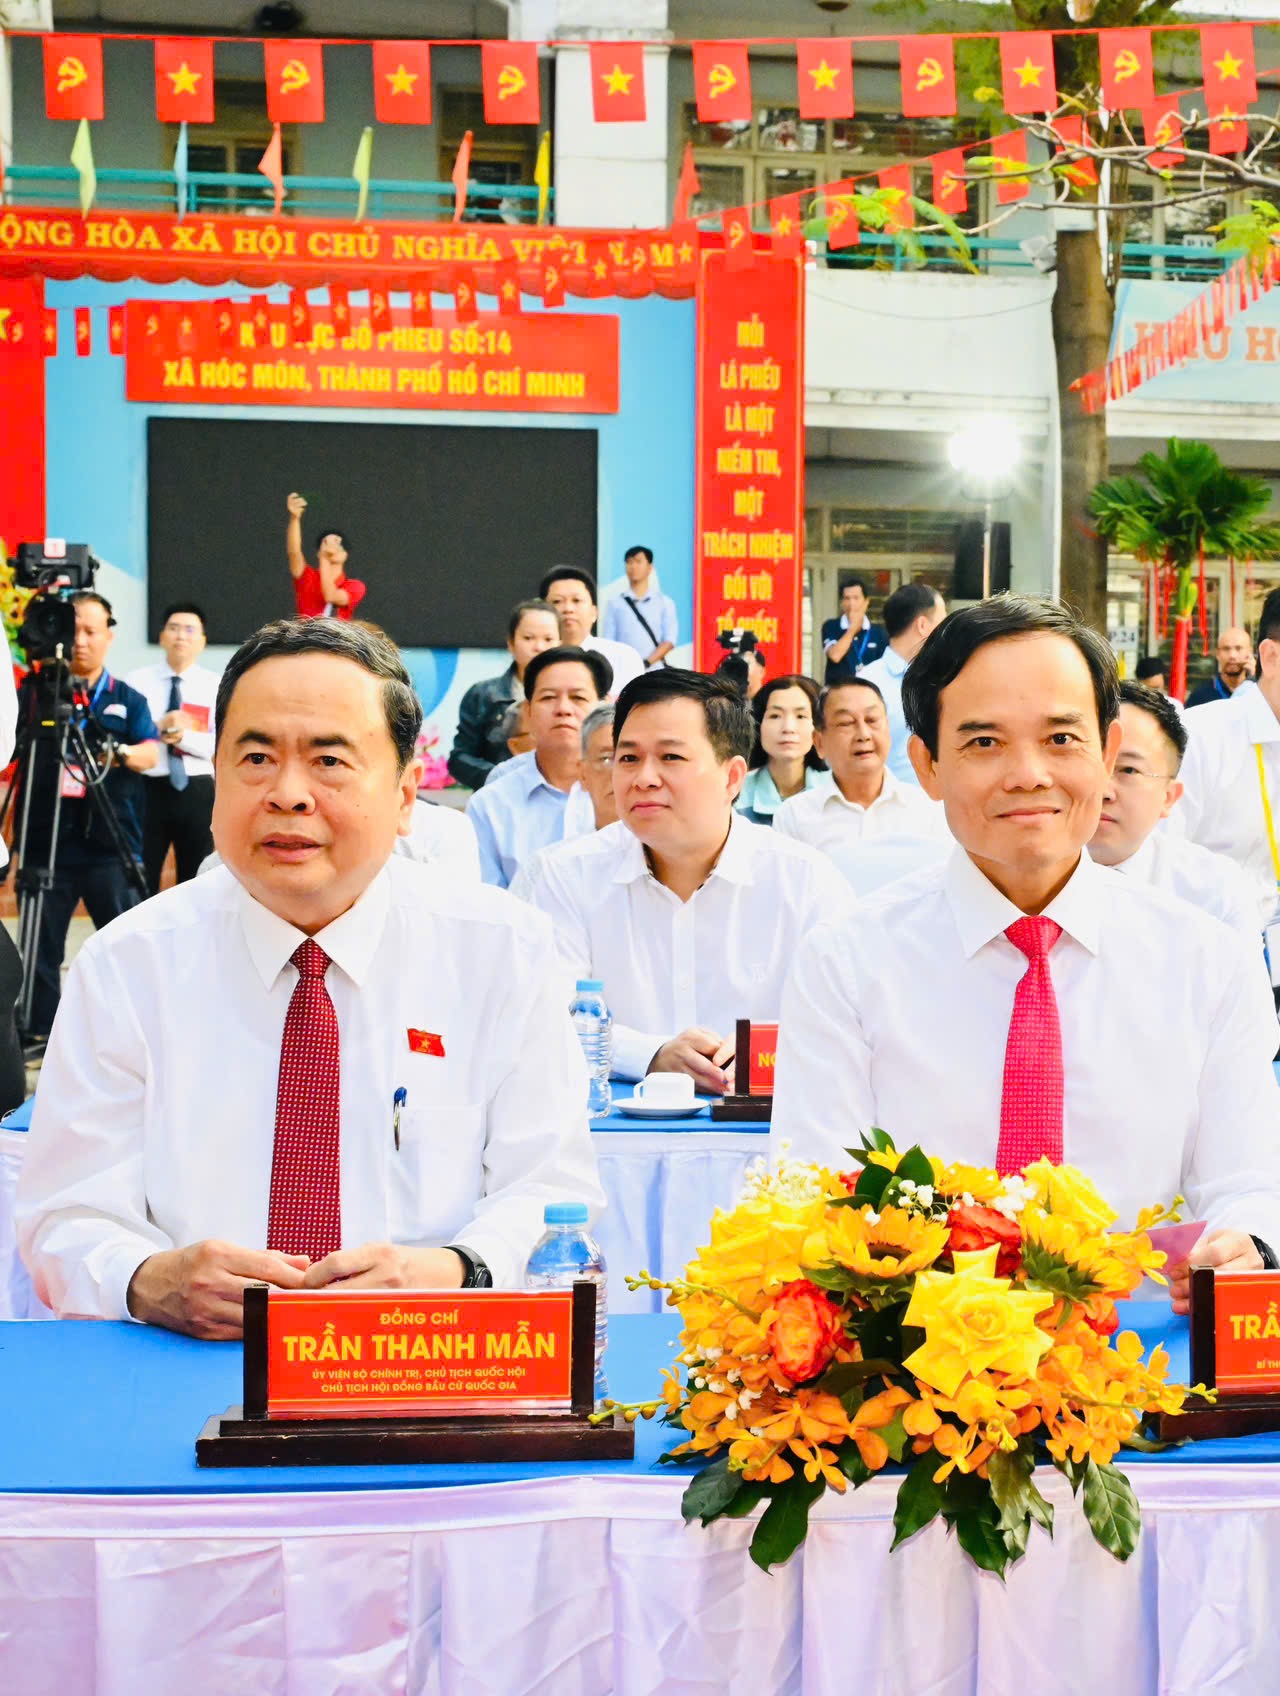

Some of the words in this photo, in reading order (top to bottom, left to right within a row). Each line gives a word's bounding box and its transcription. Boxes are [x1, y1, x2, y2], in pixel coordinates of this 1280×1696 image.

[0, 212, 74, 249] ỘNG
[85, 217, 162, 249] HÒA
[171, 223, 222, 252] XÃ
[233, 224, 296, 261] HỘI
[308, 225, 380, 257] CHỦ
[393, 230, 501, 261] NGHĨA
[608, 240, 674, 266] NM
[240, 322, 287, 348] KU
[449, 322, 512, 355] SỐ:14
[163, 356, 195, 386] XÃ
[200, 357, 247, 389] HÓC
[252, 359, 312, 392] MÔN,
[318, 362, 391, 392] THÀNH
[397, 360, 443, 393] PHỐ
[448, 362, 477, 395] HỒ
[484, 366, 521, 396] CHÍ
[526, 371, 585, 397] MINH
[720, 358, 737, 389] LÁ
[740, 357, 780, 390] PHIẾU
[380, 1307, 426, 1325] ĐỒNG
[431, 1309, 458, 1325] CHÍ
[282, 1321, 361, 1362] TRẦN
[371, 1333, 475, 1361] THANH
[486, 1320, 555, 1359] MẪN
[312, 1368, 326, 1379] ỦY
[328, 1368, 350, 1379] VIÊN
[353, 1368, 367, 1380] BỘ
[370, 1368, 402, 1379] CHÍNH
[405, 1368, 423, 1380] TRỊ,
[424, 1367, 447, 1378] CHỦ
[449, 1368, 472, 1379] TỊCH
[475, 1366, 504, 1377] QUỐC
[507, 1366, 526, 1378] HỘI
[321, 1381, 343, 1392] CHỦ
[345, 1382, 369, 1393] TỊCH
[372, 1381, 390, 1393] HỘI
[392, 1380, 423, 1391] ĐỒNG
[425, 1380, 446, 1391] BẦU
[448, 1379, 463, 1391] CỬ
[465, 1379, 495, 1391] QUỐC
[498, 1381, 517, 1391] GIA
